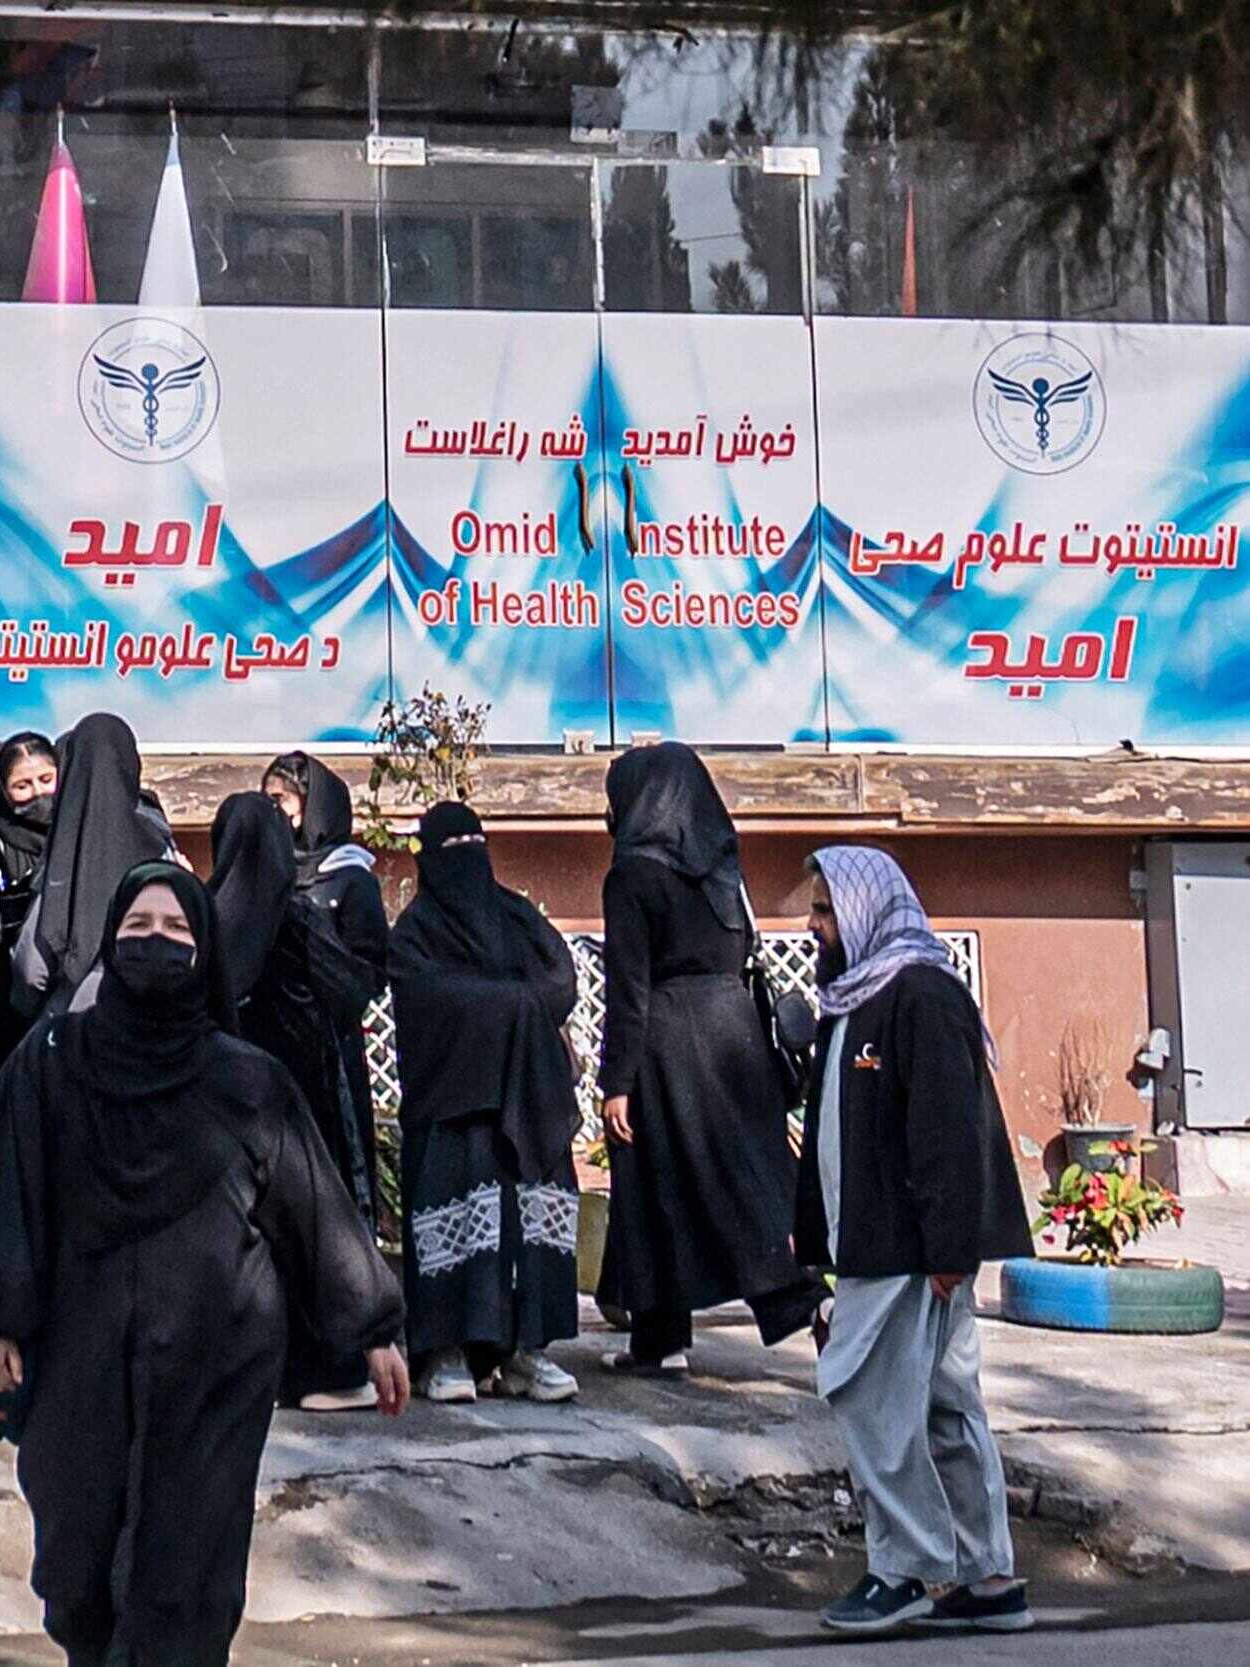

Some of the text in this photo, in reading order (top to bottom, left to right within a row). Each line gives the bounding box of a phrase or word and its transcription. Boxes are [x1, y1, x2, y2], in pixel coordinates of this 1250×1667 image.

[405, 420, 529, 462] راغلاست
[623, 414, 795, 465] خوش آمدید
[64, 505, 223, 584] امید
[452, 511, 785, 555] Omid nstitute
[851, 521, 1238, 588] انستیتوت علوم صحی
[420, 582, 799, 626] of Health Sciences
[117, 624, 214, 675] علومو
[225, 634, 308, 679] صحی
[321, 637, 340, 668] د
[964, 619, 1136, 697] امید
